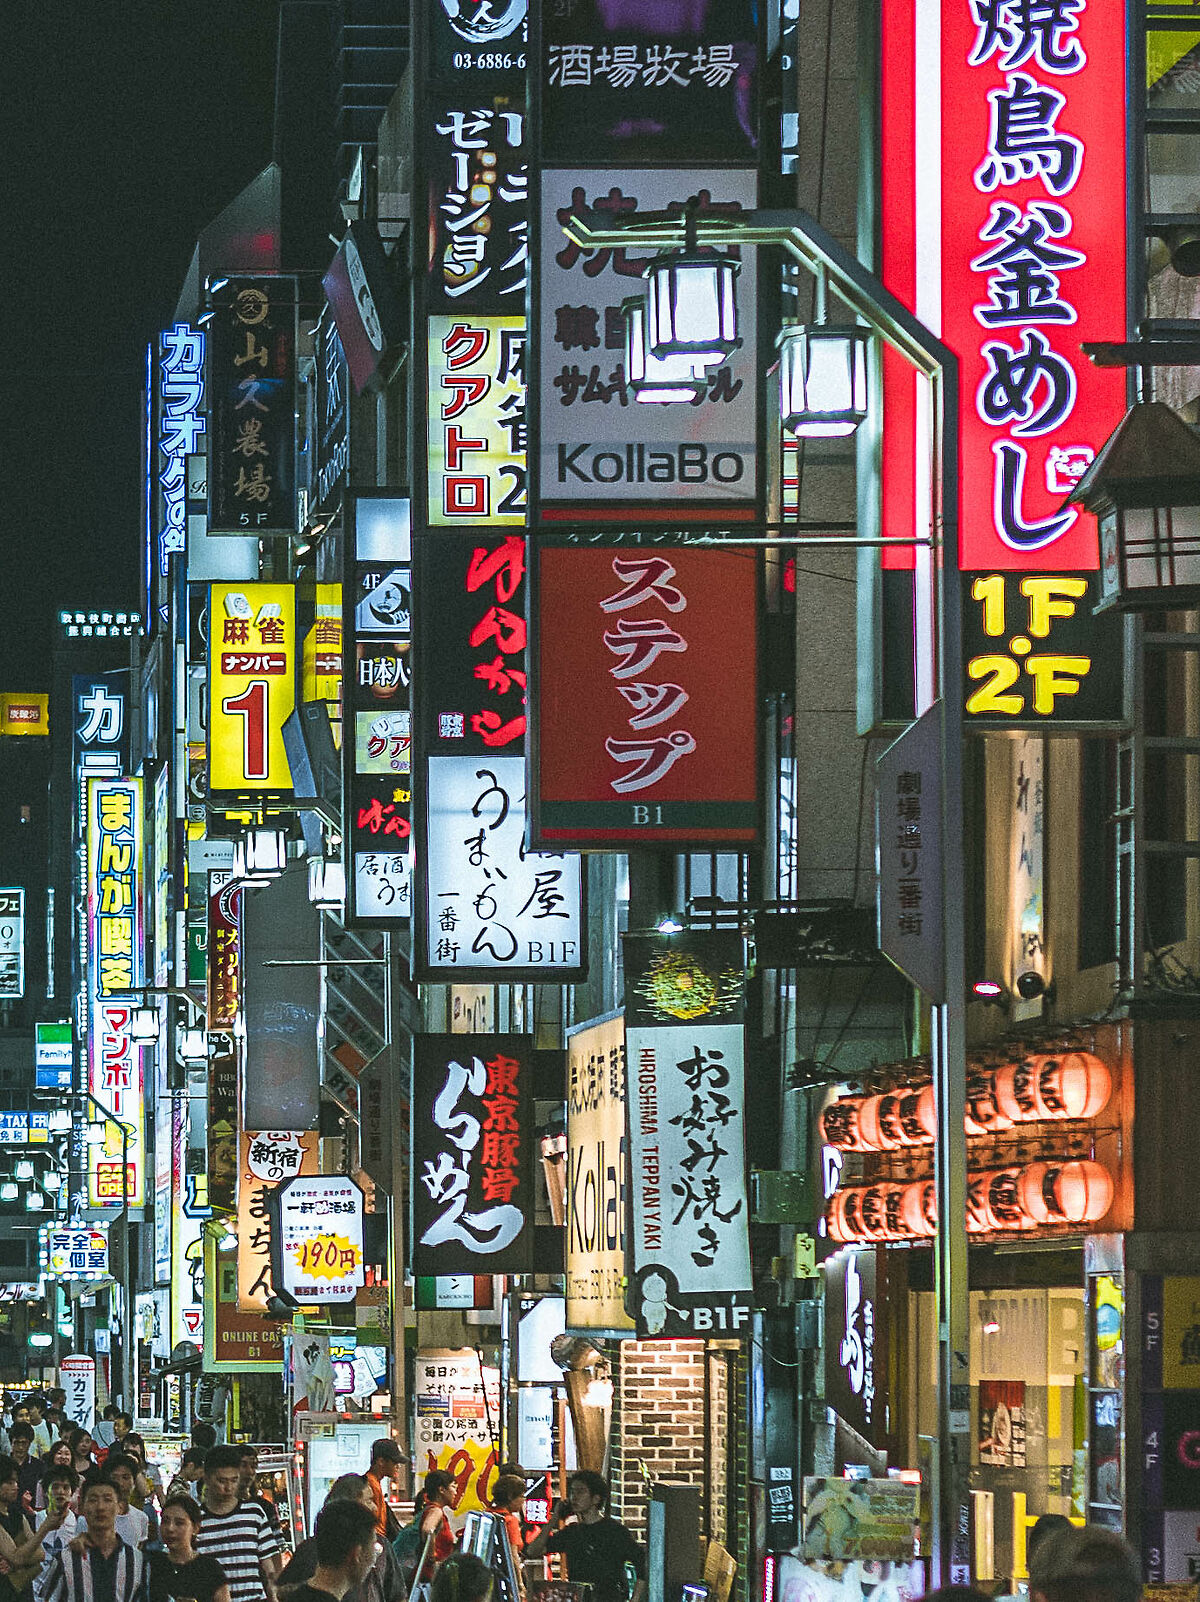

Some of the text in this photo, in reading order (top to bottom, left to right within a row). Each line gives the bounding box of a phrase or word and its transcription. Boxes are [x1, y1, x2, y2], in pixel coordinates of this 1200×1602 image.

[549, 44, 740, 89] 酒場牧場
[969, 0, 1087, 550] 焼鳥釜めし
[441, 323, 491, 518] クアトロ
[557, 443, 744, 483] KollaBo
[362, 573, 381, 590] 4F
[972, 574, 1089, 638] 1F
[222, 616, 286, 646] 麻雀
[224, 655, 286, 673] ナンバー
[600, 555, 697, 794] ステップ
[966, 653, 1092, 716] 2F
[221, 679, 270, 781] 1
[632, 805, 664, 826] B1
[98, 789, 135, 1001] まんが喫茶
[463, 769, 518, 963] うまいもん
[434, 890, 461, 964] 一番街
[527, 941, 576, 963] B1F
[103, 1005, 132, 1116] マンボー
[639, 1047, 658, 1137] HIROSHIMA
[6, 1115, 28, 1128] TAX
[482, 1053, 521, 1203] 東京豚骨
[668, 1045, 743, 1269] お好み焼き
[53, 1234, 90, 1251] 完全
[69, 1251, 106, 1269] 個室
[301, 1240, 356, 1269] 190円
[693, 1306, 751, 1331] B1F
